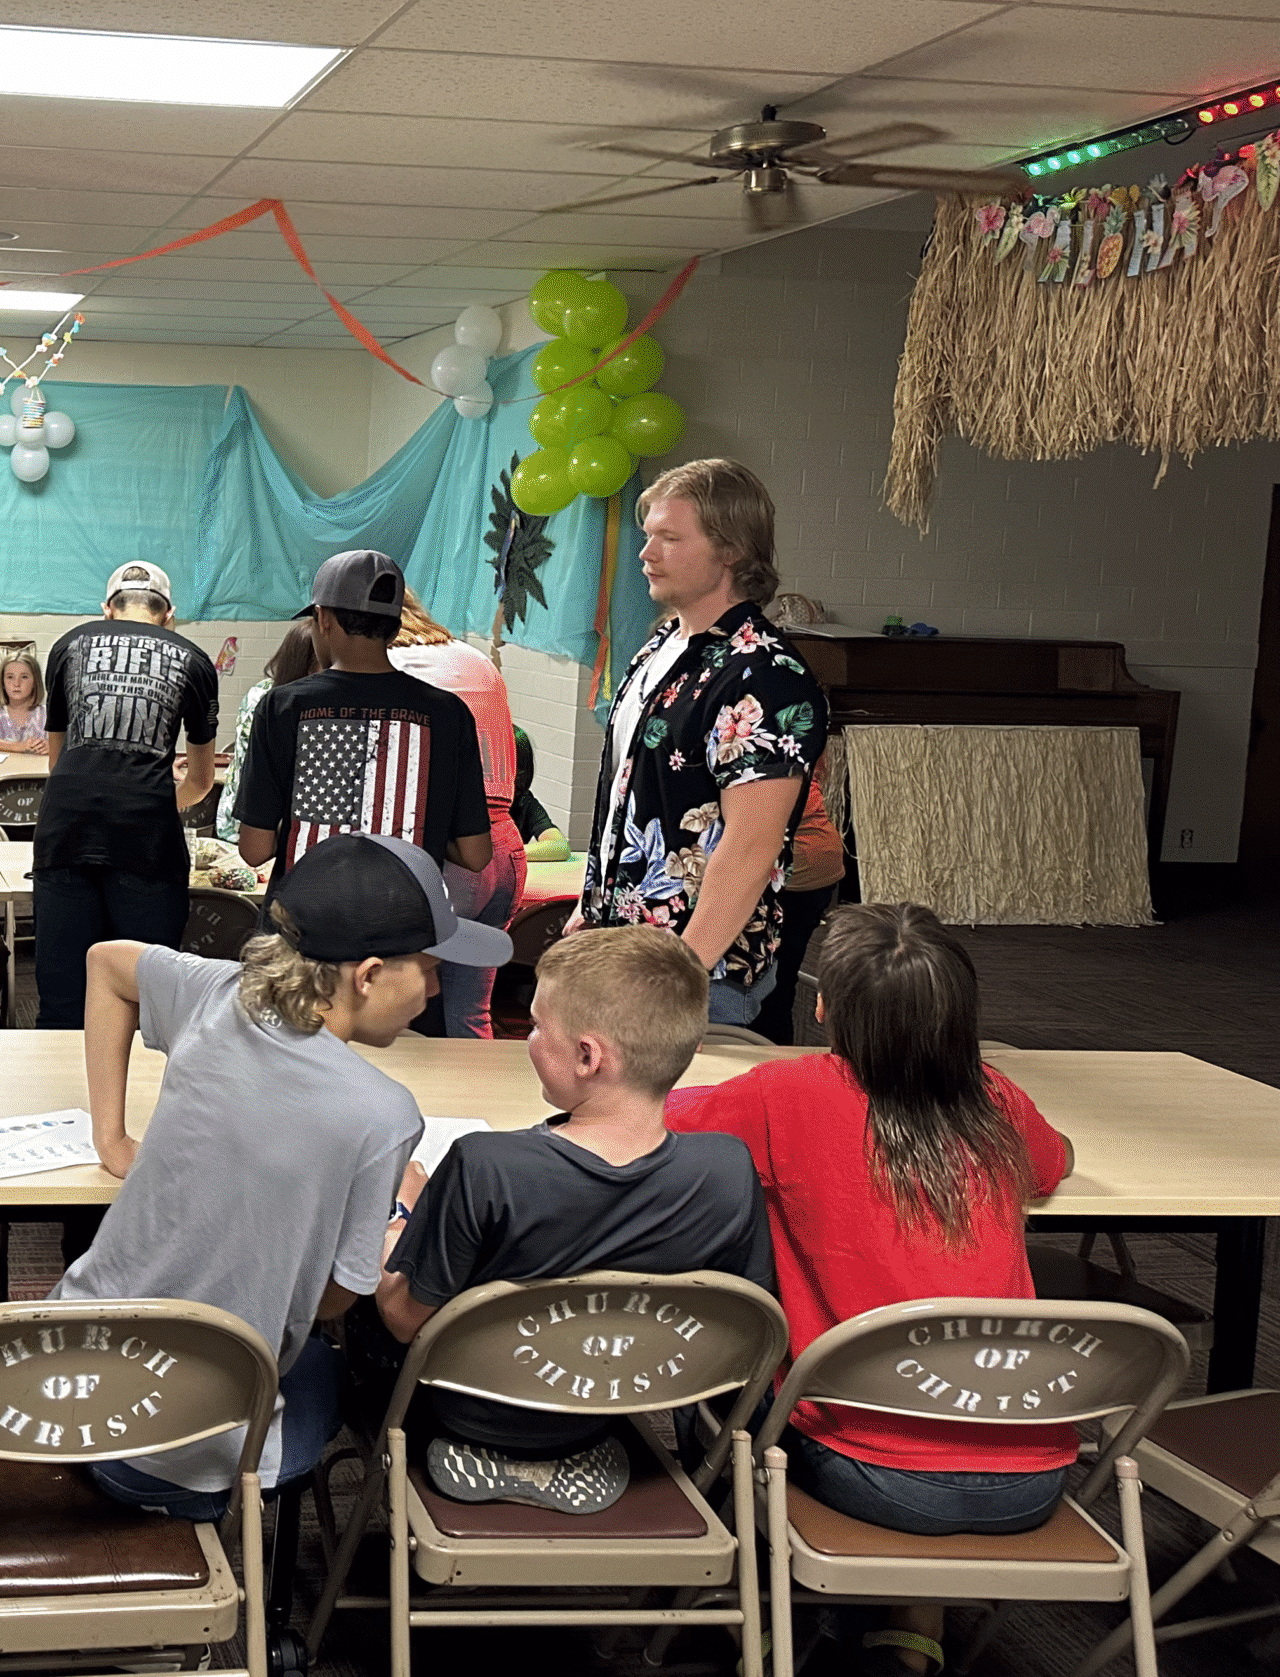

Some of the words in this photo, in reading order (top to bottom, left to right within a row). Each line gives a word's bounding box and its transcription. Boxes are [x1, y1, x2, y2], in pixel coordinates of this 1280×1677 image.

[91, 635, 131, 647] THIS
[137, 639, 157, 651] IS
[162, 643, 188, 661] MY
[86, 646, 185, 690] RIFLE
[88, 673, 111, 682] THERE
[113, 674, 128, 682] ARE
[130, 676, 154, 686] MANY
[155, 681, 172, 695] LIKE
[99, 683, 119, 692] BUT
[121, 685, 144, 694] THIS
[300, 707, 336, 720] HOME
[340, 707, 356, 718] OF
[361, 708, 387, 720] THE
[391, 709, 430, 725] BRAVE
[17, 798, 34, 806] OF
[517, 1291, 704, 1342] CHURCH
[582, 1335, 635, 1357] OF
[908, 1319, 1103, 1358] CHURCH
[974, 1348, 1031, 1370] OF
[513, 1345, 685, 1400] CHRIST
[896, 1359, 1077, 1412] CHRIST
[41, 1374, 100, 1400] OF
